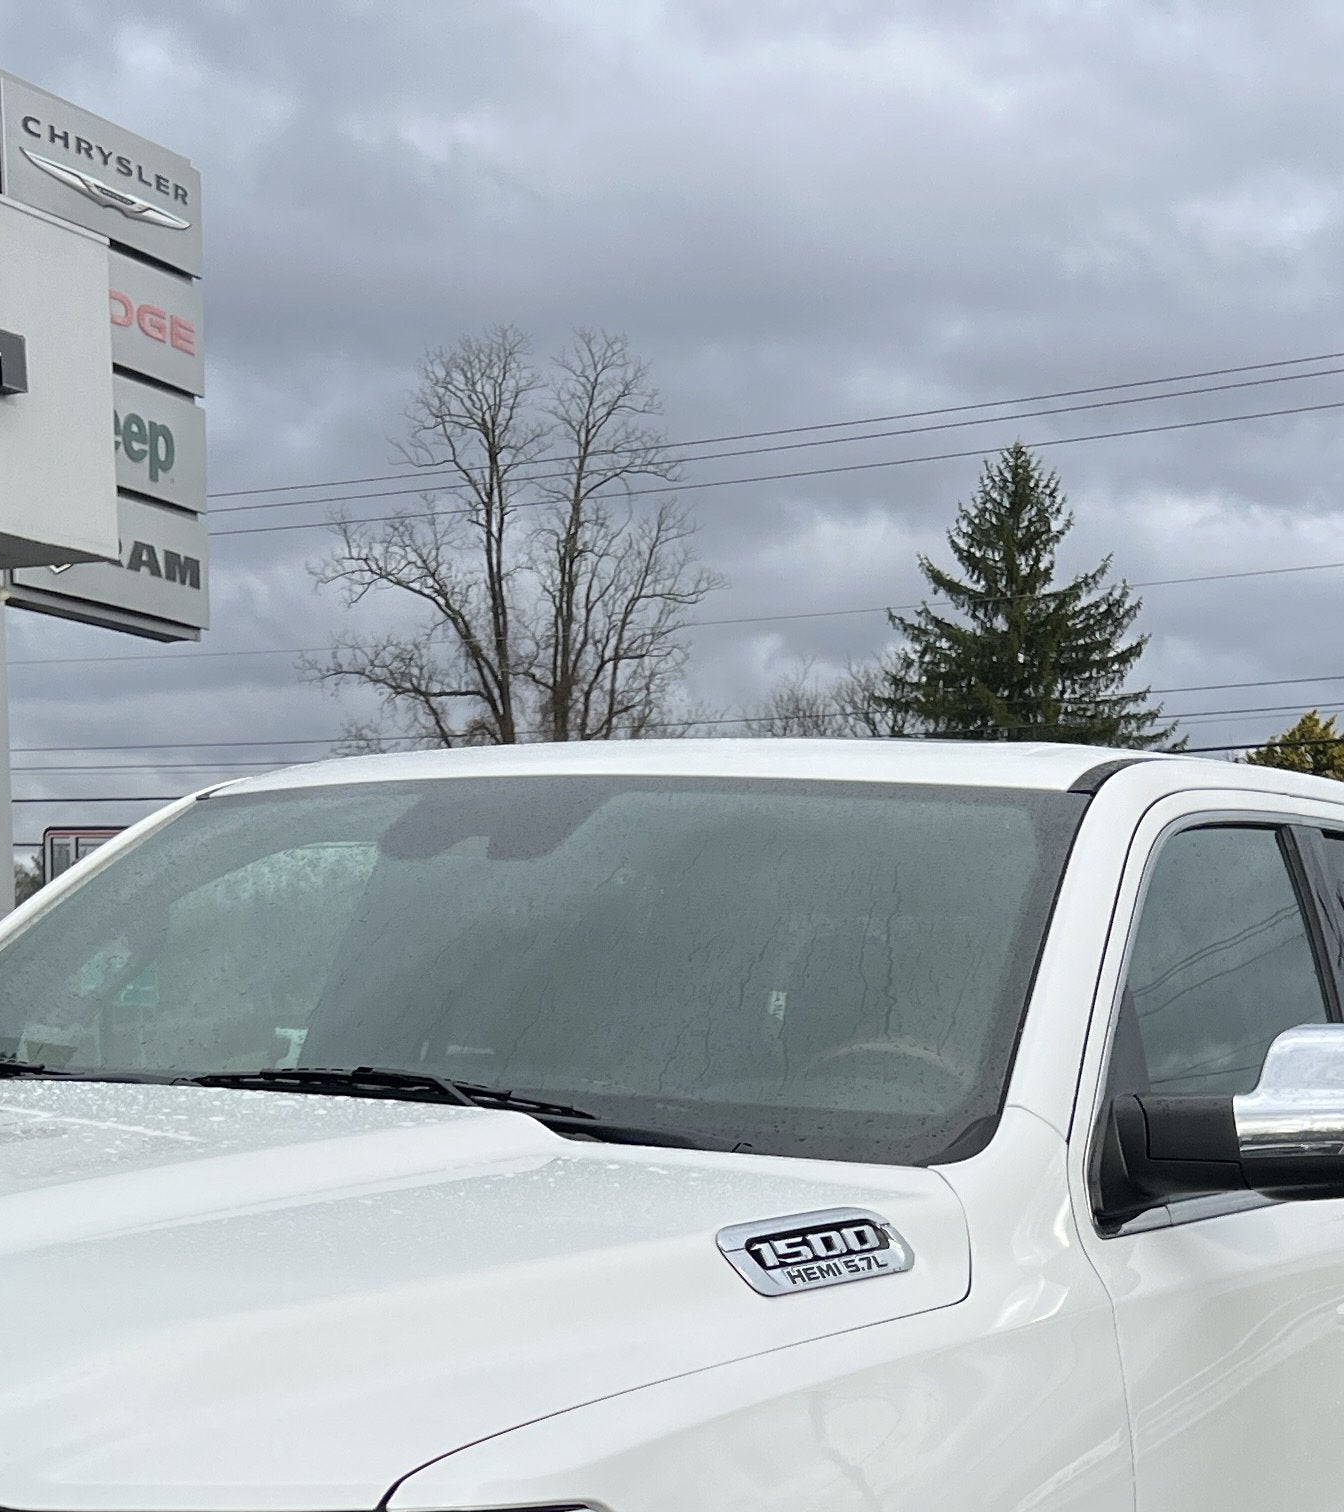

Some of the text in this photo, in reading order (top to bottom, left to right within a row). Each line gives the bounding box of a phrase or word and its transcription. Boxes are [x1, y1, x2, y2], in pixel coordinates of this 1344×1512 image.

[22, 116, 189, 205] CHRYSLER
[113, 409, 174, 482] ep
[118, 537, 200, 590] AM
[752, 1224, 881, 1268] 1500
[787, 1255, 889, 1285] HEMI 5.7L
